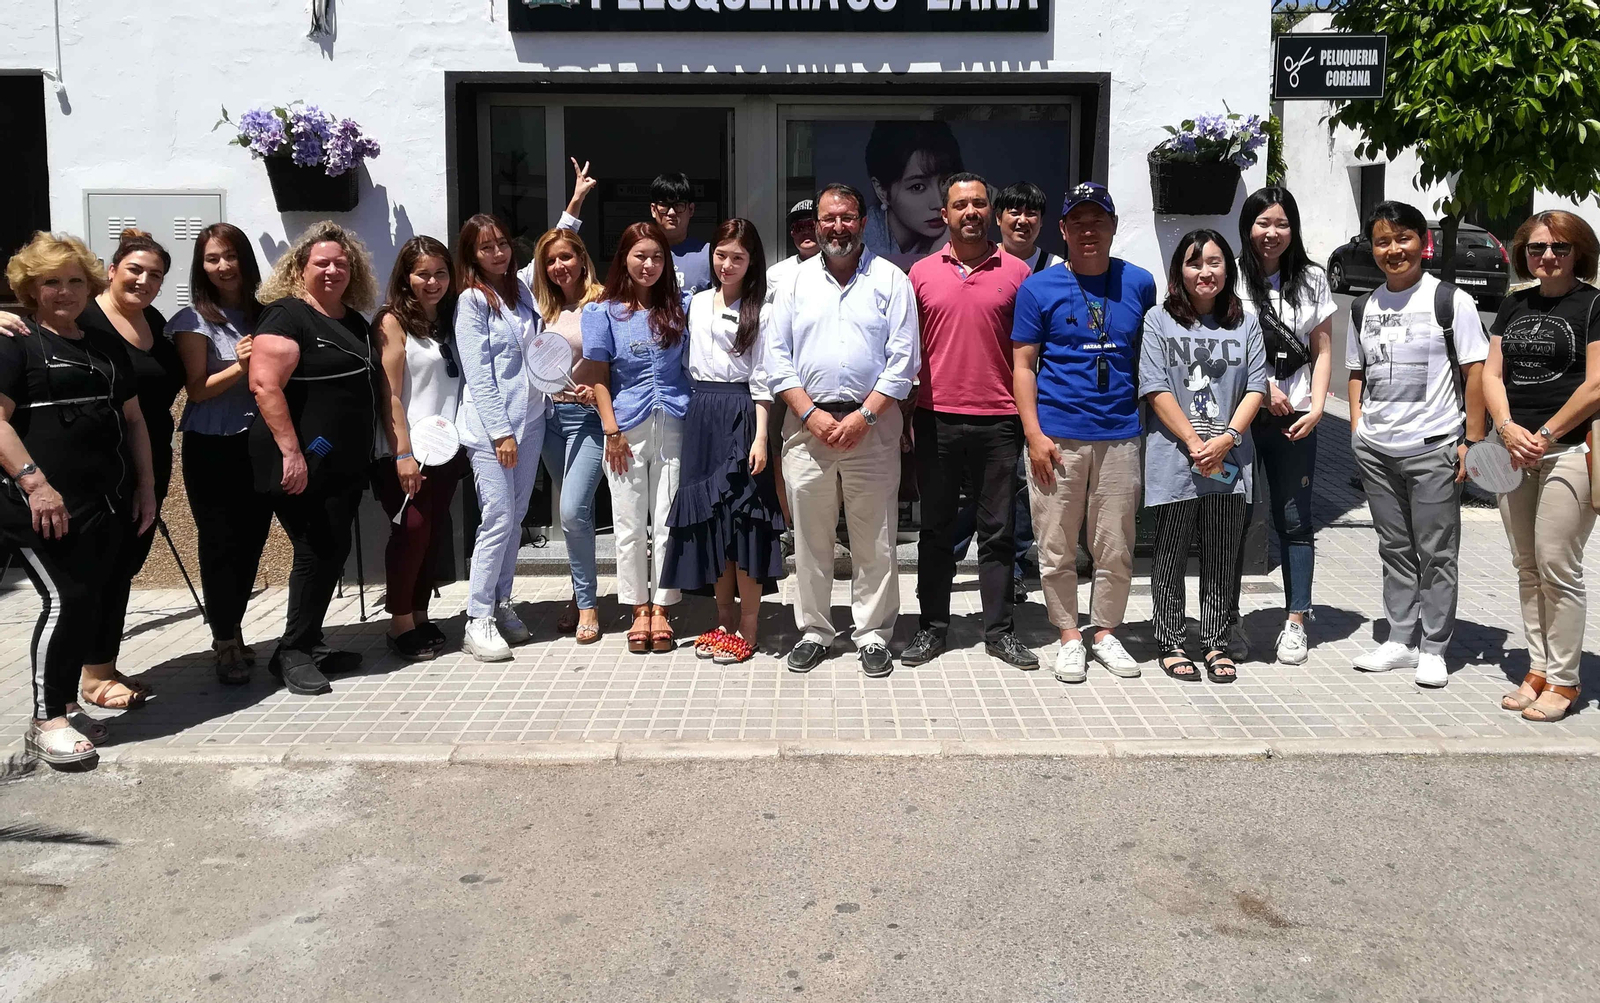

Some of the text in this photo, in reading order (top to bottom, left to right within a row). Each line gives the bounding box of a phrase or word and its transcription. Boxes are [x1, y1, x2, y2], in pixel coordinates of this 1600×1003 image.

[1320, 49, 1379, 67] PELUQUERIA
[1325, 70, 1371, 87] COREANA
[1166, 336, 1242, 368] NYC
